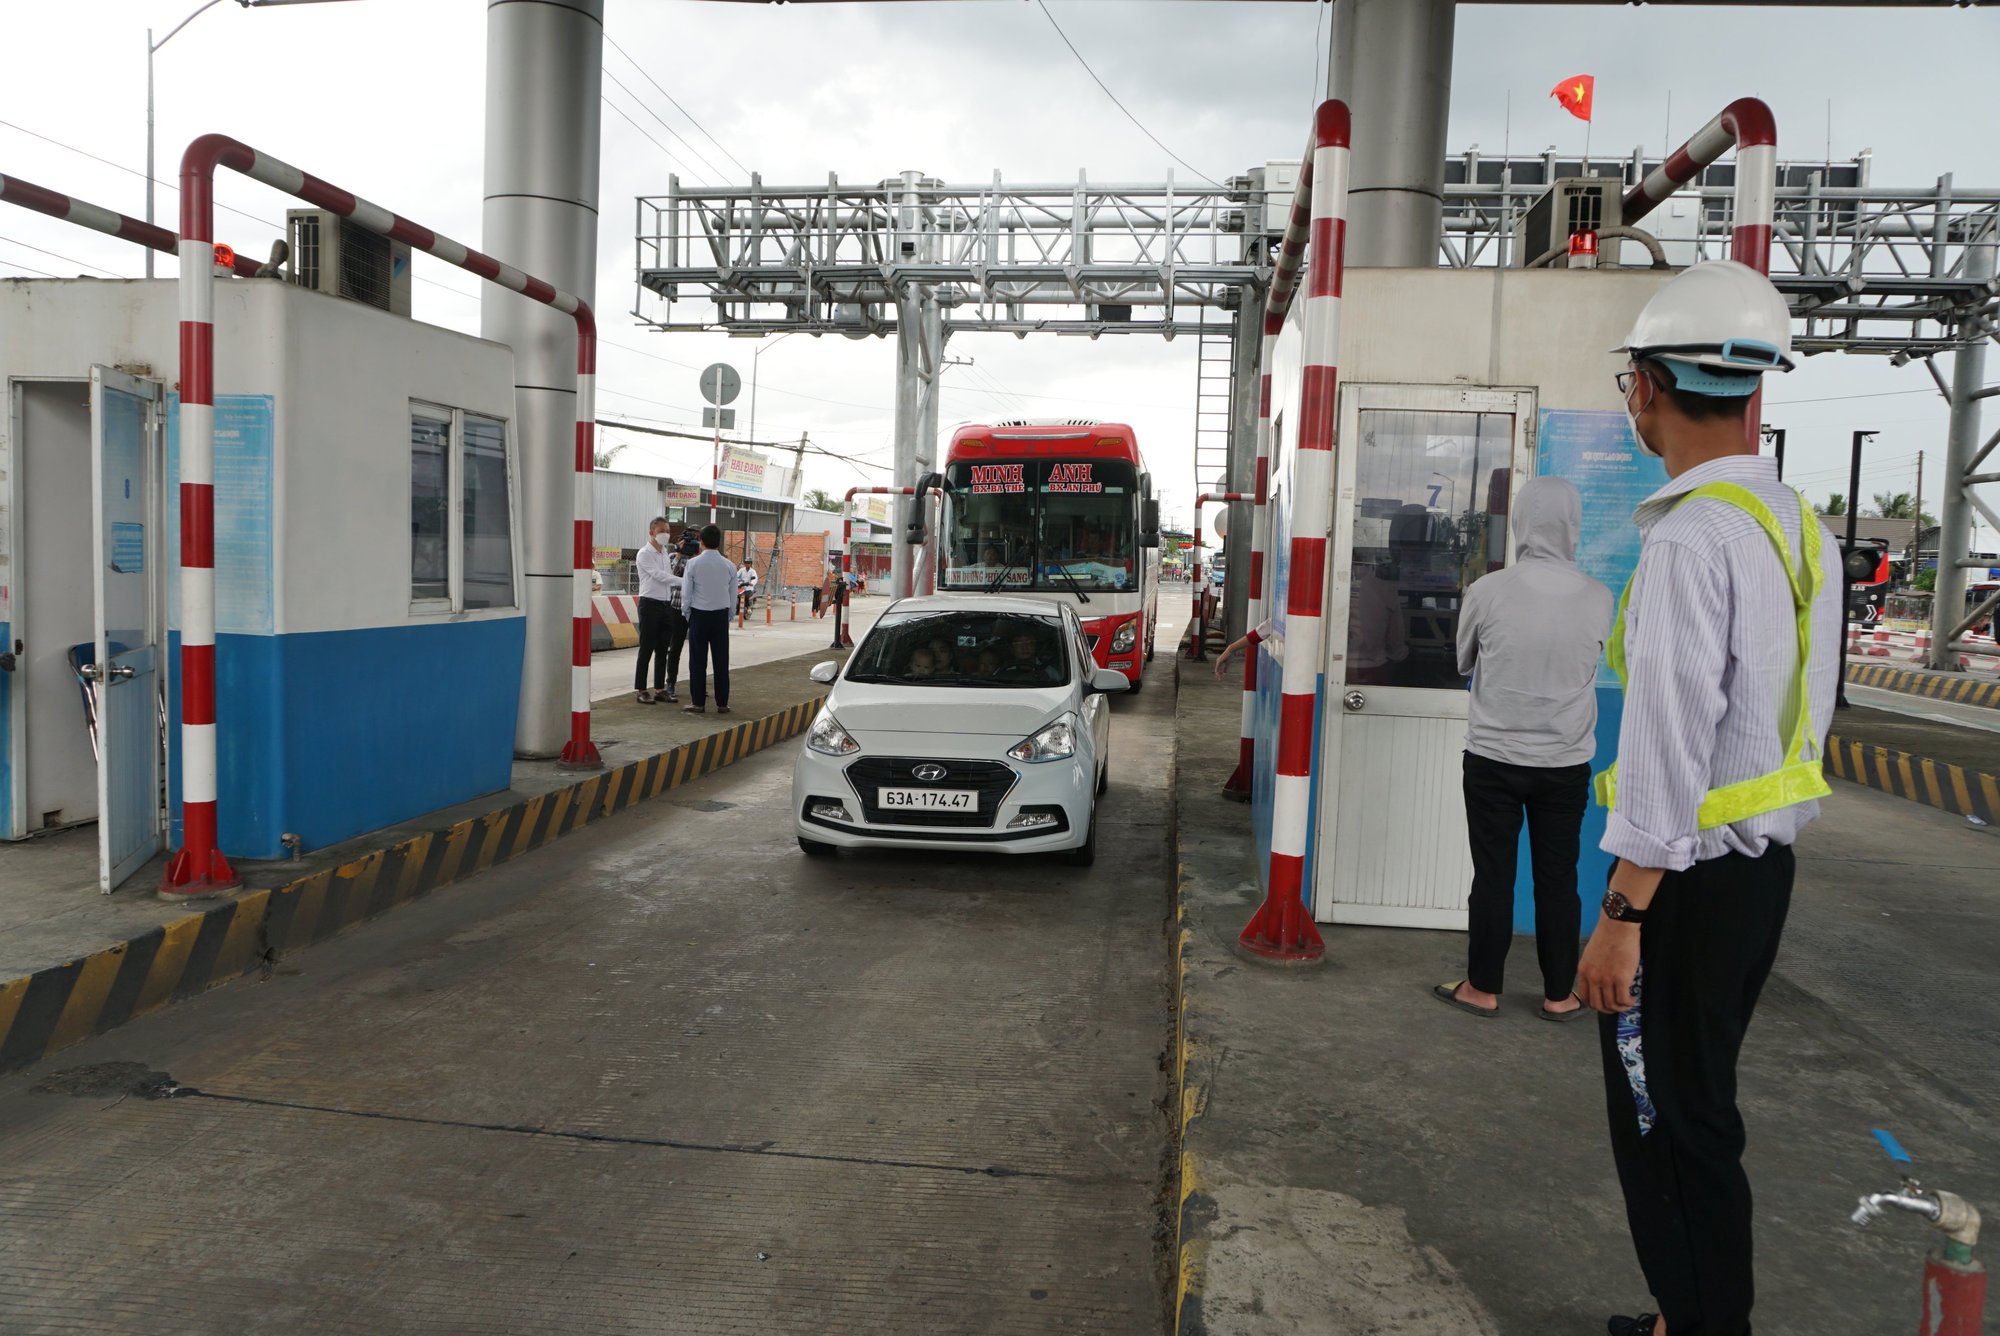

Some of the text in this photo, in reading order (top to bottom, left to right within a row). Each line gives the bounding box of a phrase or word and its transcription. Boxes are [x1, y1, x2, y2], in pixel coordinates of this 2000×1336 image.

[971, 463, 1092, 484] MINH ANH
[1426, 485, 1442, 507] 7
[1007, 572, 1028, 583] SANG
[886, 791, 970, 808] 63A-174.47
